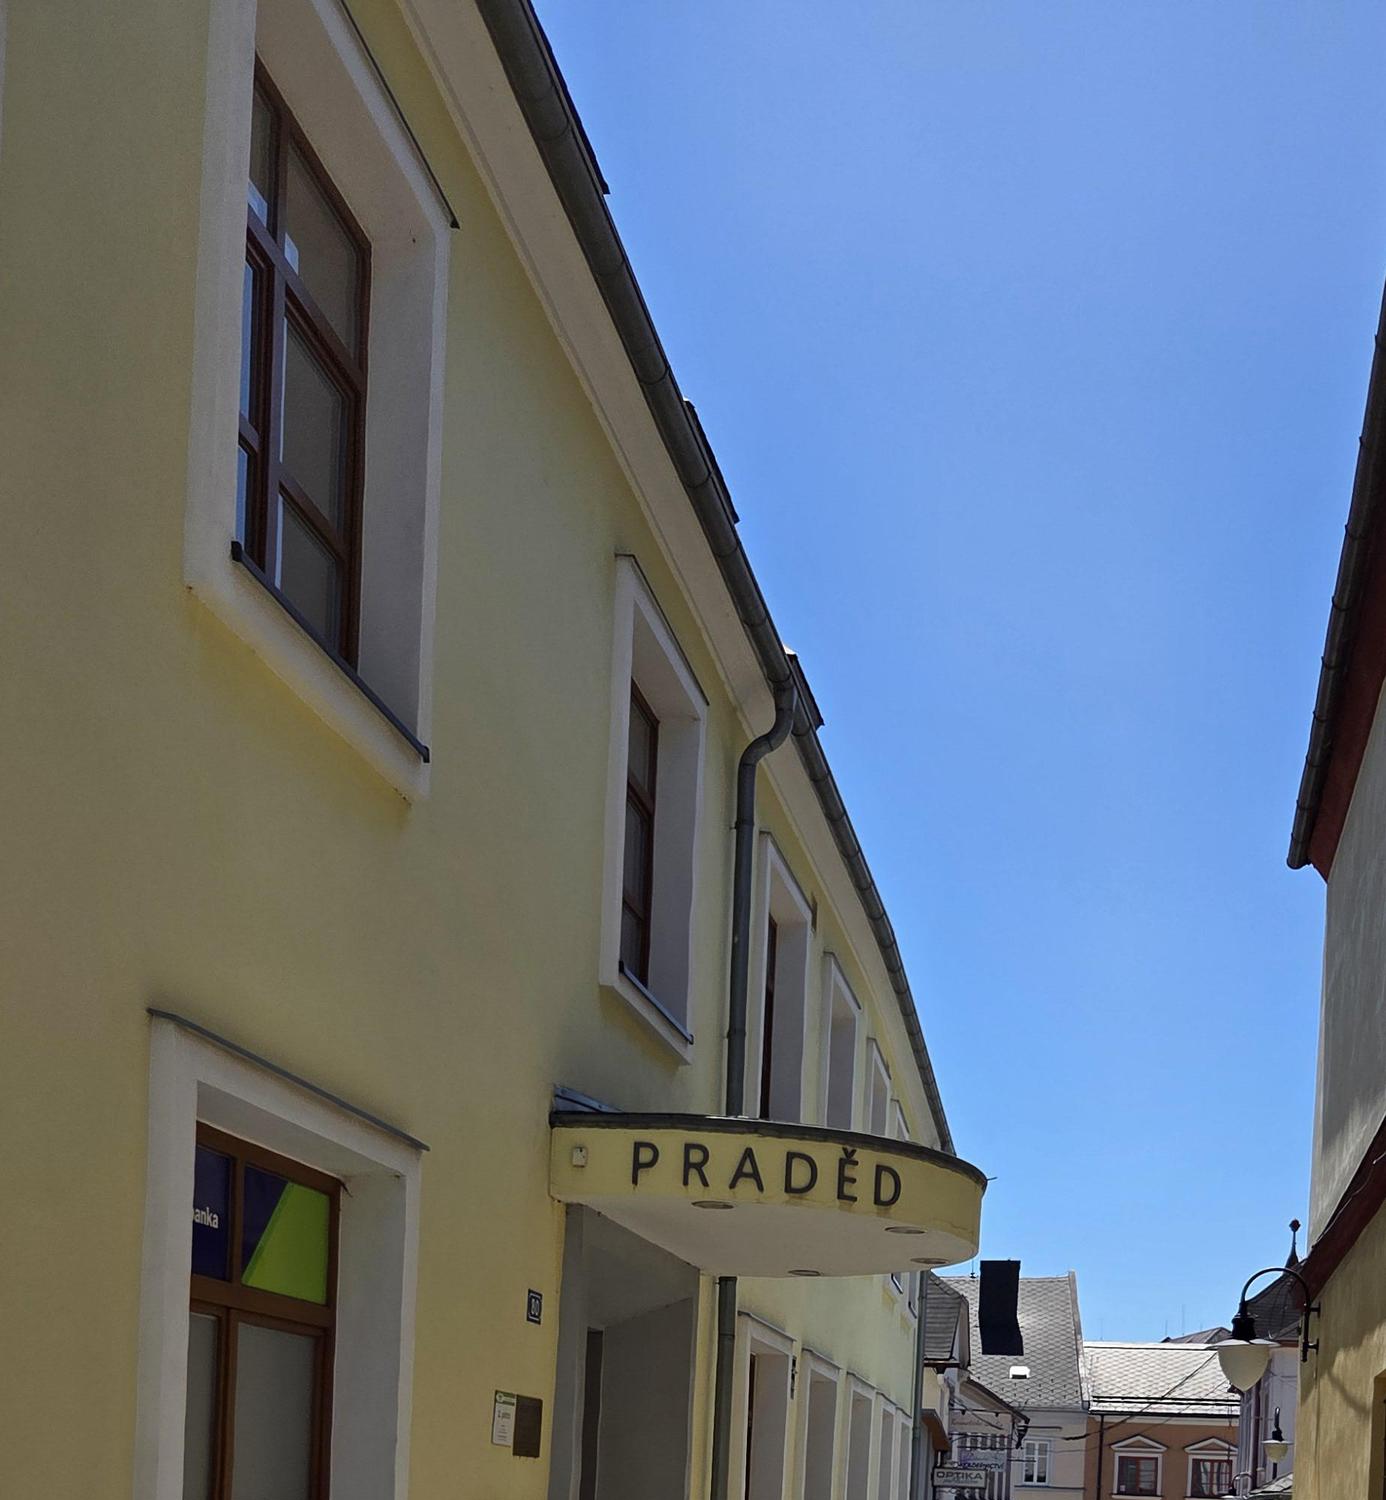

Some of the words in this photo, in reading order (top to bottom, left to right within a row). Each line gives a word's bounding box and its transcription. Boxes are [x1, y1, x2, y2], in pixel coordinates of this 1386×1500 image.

[631, 1140, 902, 1207] PRADĚD
[192, 1206, 219, 1229] anka
[936, 1471, 983, 1479] OPTIKA
